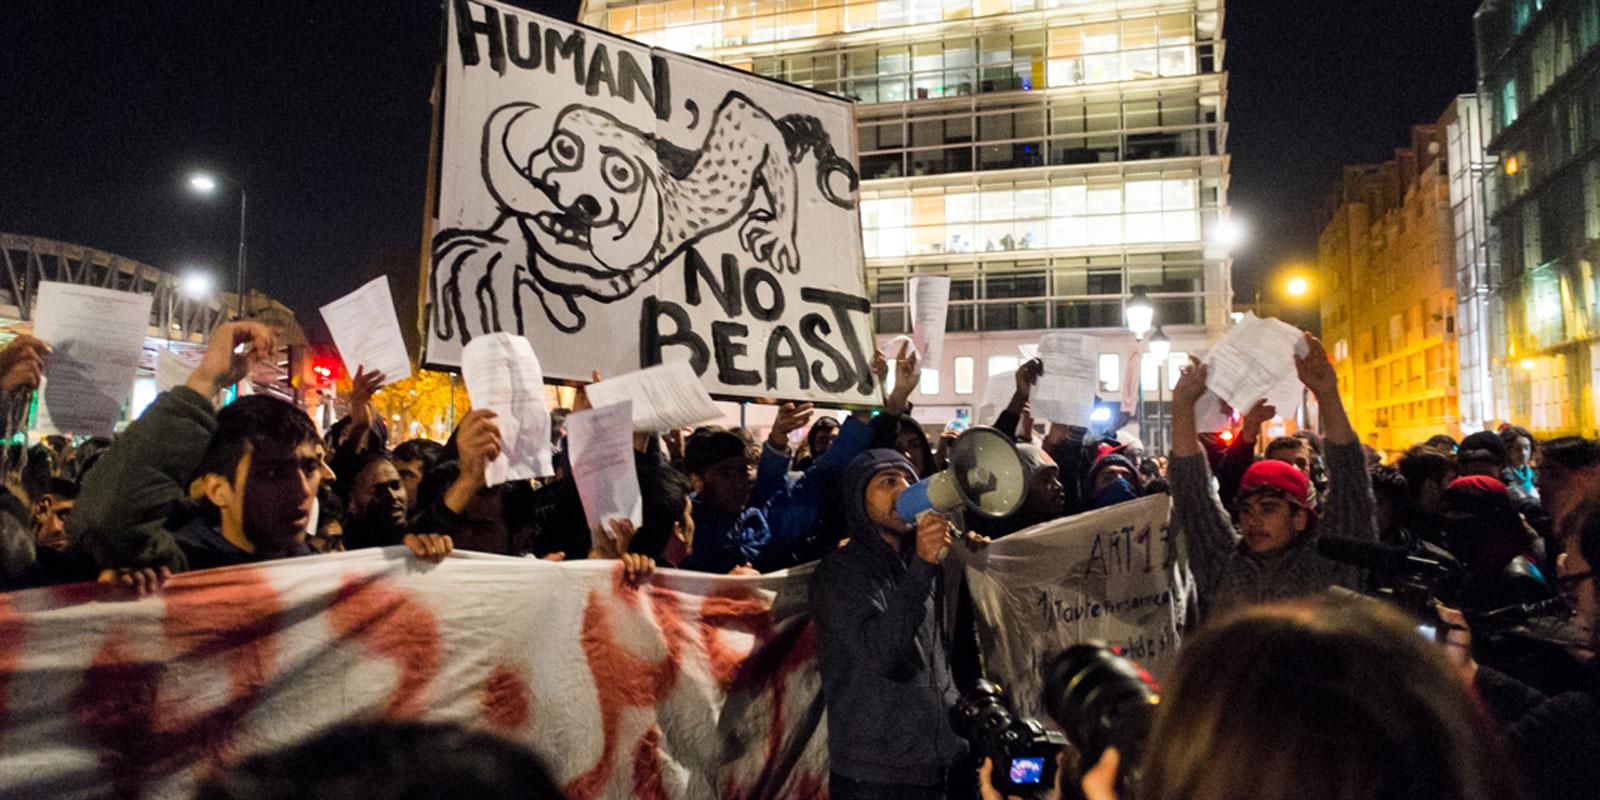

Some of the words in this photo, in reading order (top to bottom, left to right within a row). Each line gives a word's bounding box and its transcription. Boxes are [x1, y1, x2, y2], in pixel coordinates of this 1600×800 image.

[457, 0, 699, 129] HUMAN,
[684, 246, 785, 322] NO
[640, 286, 870, 396] BEAST
[1085, 525, 1135, 578] ART
